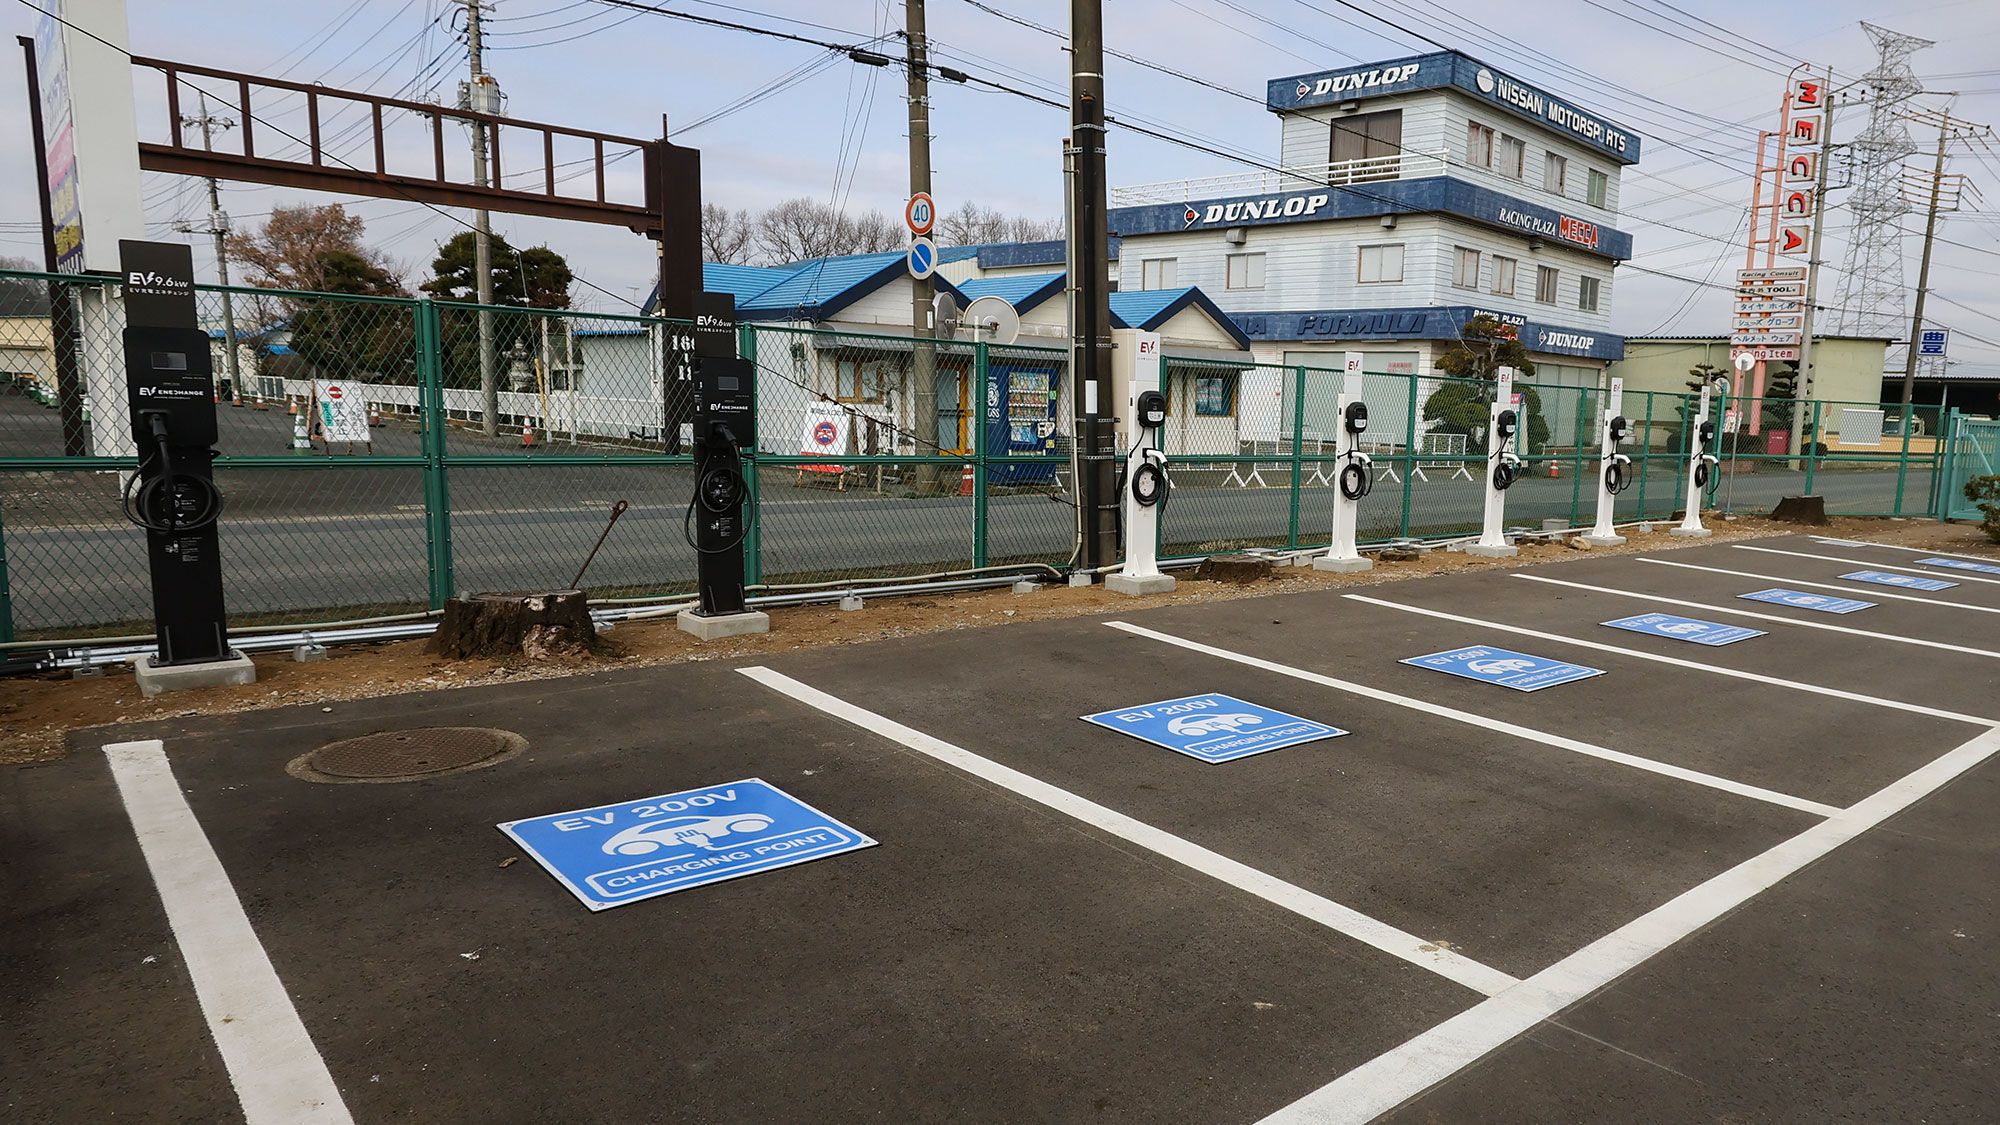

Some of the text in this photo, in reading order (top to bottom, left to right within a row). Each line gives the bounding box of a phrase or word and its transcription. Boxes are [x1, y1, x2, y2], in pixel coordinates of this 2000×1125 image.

[1312, 63, 1420, 96] DUNLOP
[1497, 78, 1543, 116] NISSAN
[1783, 82, 1818, 251] MECCA
[913, 205, 929, 222] 40
[1203, 194, 1328, 224] DUNLOP
[1498, 207, 1599, 250] RACING PLAZA MECCA
[129, 272, 188, 288] EV 9.6kW
[1740, 303, 1764, 311] タイヤ
[1502, 315, 1525, 326] PLAZA
[1738, 317, 1795, 326] シューズ グローブ
[1140, 341, 1155, 354] EV
[1547, 332, 1595, 350] DUNLOP
[1733, 334, 1793, 343] ヘルメット ウェア
[1920, 331, 1945, 353] 豊
[1769, 350, 1793, 358] Item
[1424, 649, 1495, 666] EV 200V
[1114, 698, 1220, 723] EV 200V
[1200, 723, 1313, 755] CHARGING POINT
[551, 789, 738, 833] EV 200V
[606, 832, 829, 889] CHARGING POINT
